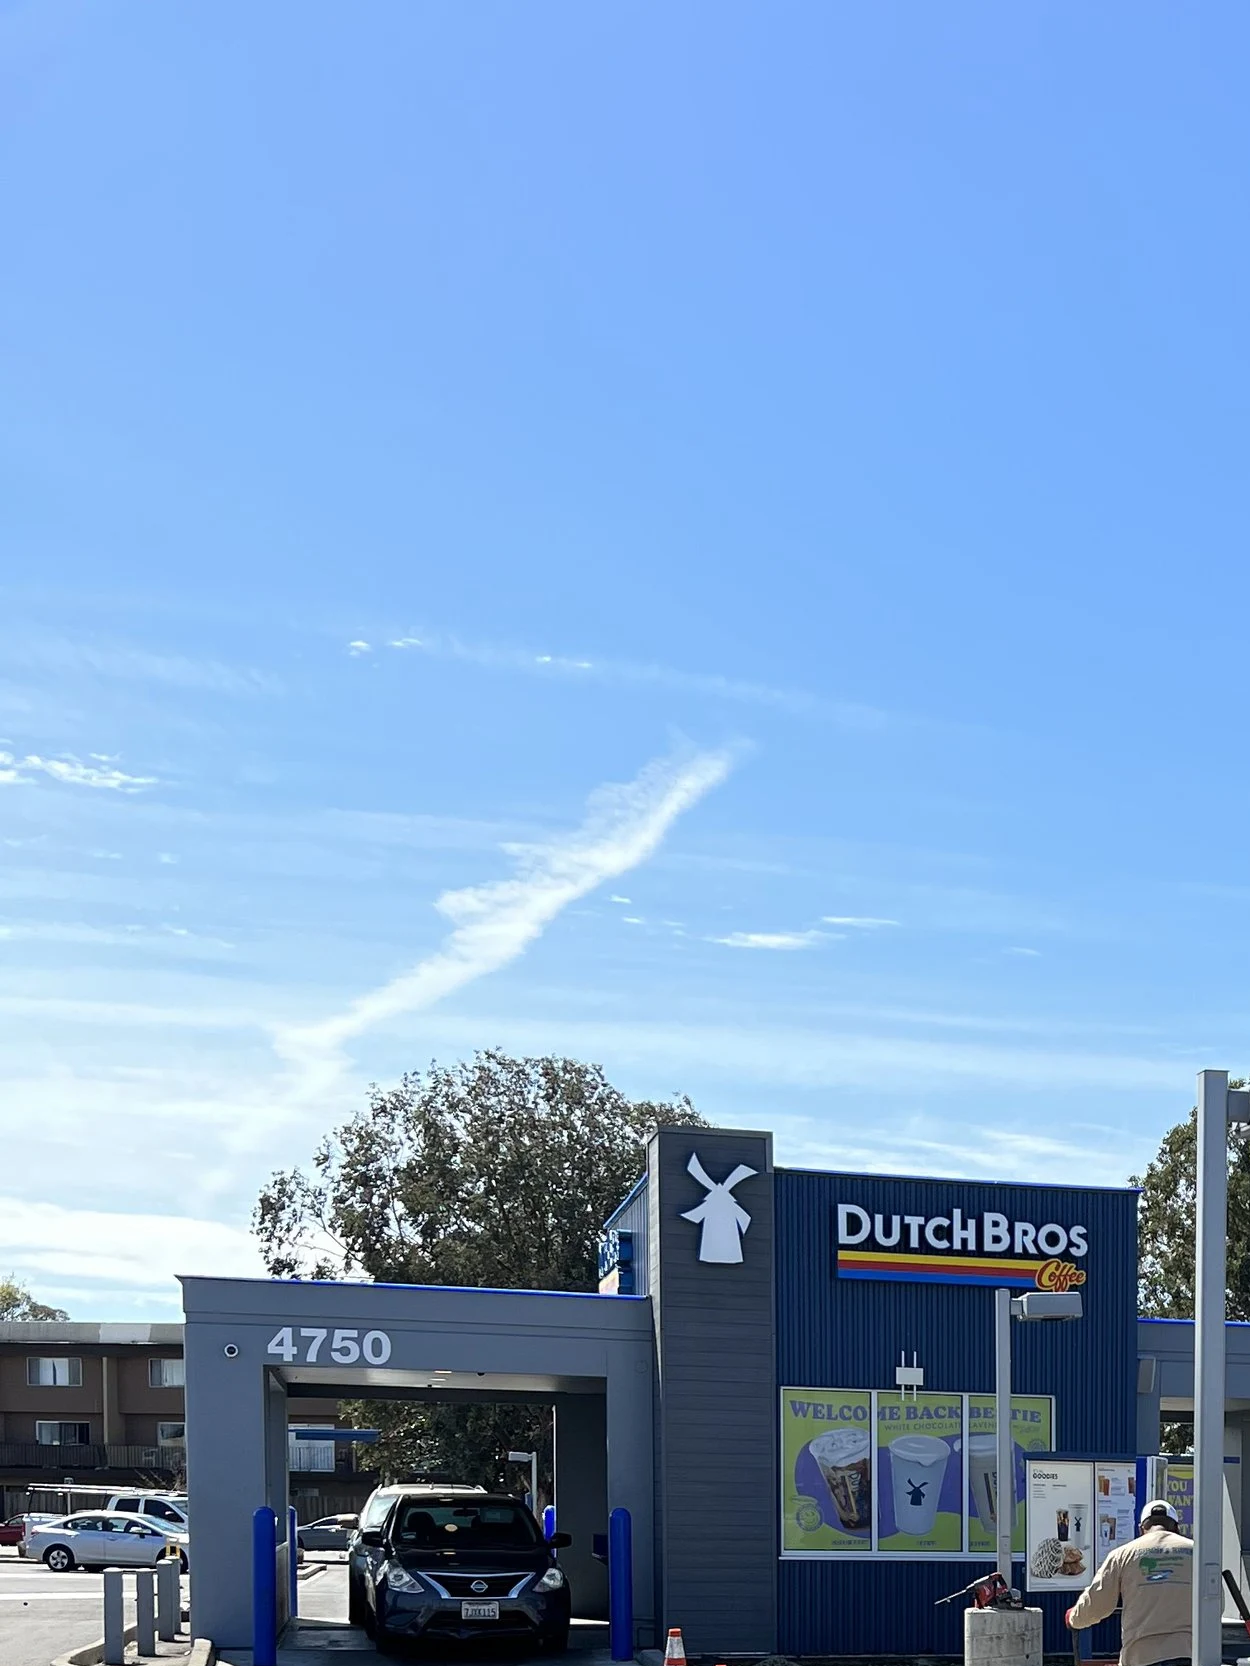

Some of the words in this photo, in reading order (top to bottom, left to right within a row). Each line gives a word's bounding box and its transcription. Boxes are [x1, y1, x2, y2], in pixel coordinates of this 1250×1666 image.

[983, 1211, 1089, 1257] BROS
[1036, 1260, 1086, 1295] Coffee
[267, 1327, 392, 1366] 4750
[905, 1406, 961, 1420] BACK
[969, 1407, 1041, 1423] BETIE
